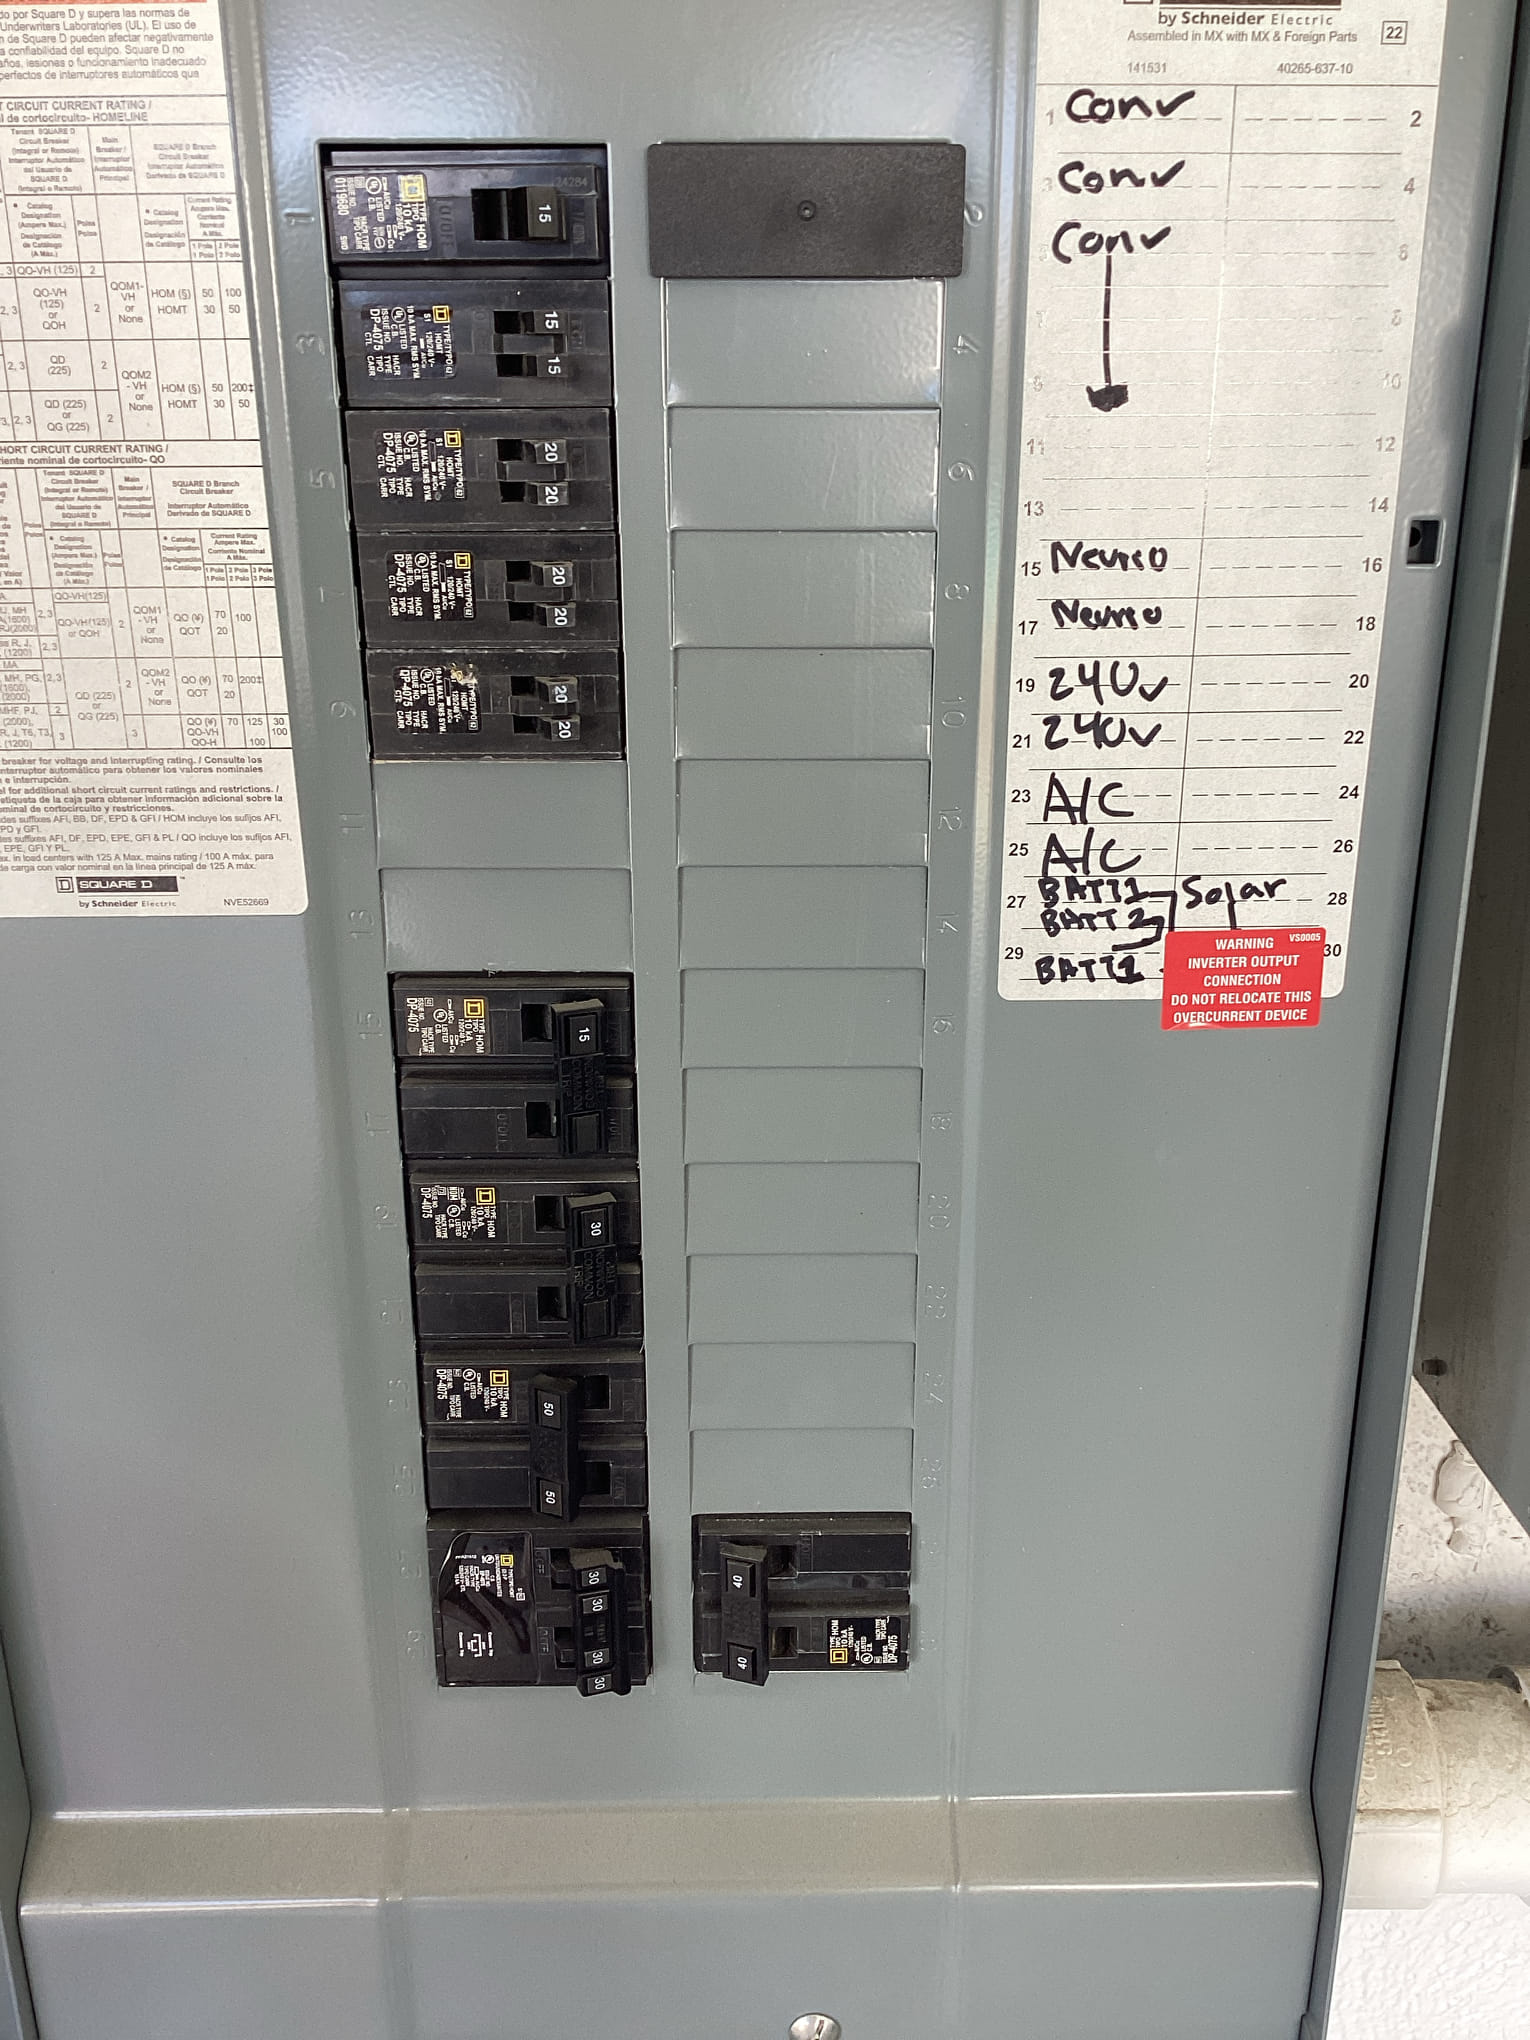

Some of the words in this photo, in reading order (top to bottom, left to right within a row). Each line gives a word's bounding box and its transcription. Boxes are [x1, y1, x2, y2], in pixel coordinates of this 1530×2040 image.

[13, 11, 28, 20] por
[31, 9, 65, 20] Square
[68, 8, 76, 18] D
[79, 11, 85, 20] y
[87, 10, 120, 20] supera
[122, 8, 137, 18] las
[139, 9, 175, 18] normas
[177, 8, 190, 18] de
[1158, 12, 1176, 27] by
[1181, 11, 1264, 25] Schneider
[1270, 13, 1333, 26] Electric
[1127, 30, 1188, 42] Assembled
[1192, 30, 1201, 42] in
[1204, 30, 1223, 42] MX
[1226, 30, 1248, 42] with
[1251, 31, 1270, 42] MX
[1273, 31, 1280, 42] &
[1284, 31, 1325, 45] Foreign
[1329, 31, 1357, 42] Parts
[1385, 26, 1403, 39] 22
[1127, 62, 1167, 74] 141531
[1276, 63, 1353, 75] 40265-637-10
[6, 101, 49, 111] CIRCUIT
[52, 100, 102, 111] CURRENT
[106, 100, 146, 110] RATING
[1065, 88, 1196, 123] Conv
[7, 113, 19, 123] de
[22, 112, 90, 123] cortocircuito-
[92, 111, 149, 122] HOMELINE
[1409, 110, 1423, 127] 2
[1057, 160, 1186, 194] Conv
[1403, 178, 1416, 194] 4
[335, 177, 350, 216] 0119680
[538, 203, 551, 224] 15
[417, 224, 426, 249] HOM
[1051, 220, 1172, 264] Conv
[151, 288, 175, 298] HOM
[201, 288, 214, 298] 50
[225, 288, 242, 298] 100
[157, 305, 188, 314] HOMT
[203, 304, 216, 314] 30
[228, 304, 241, 314] 50
[545, 311, 559, 330] 15
[369, 308, 383, 351] DP-4075
[547, 356, 561, 376] 15
[31, 444, 72, 455] CIRCUIT
[73, 444, 124, 454] CURRENT
[125, 443, 163, 453] RATING
[1375, 436, 1396, 453] 12
[27, 455, 66, 465] nominal
[67, 455, 81, 465] de
[82, 455, 148, 465] cortocircuito-
[149, 455, 166, 465] QO
[383, 432, 396, 473] DP-4075
[545, 442, 558, 463] 20
[446, 456, 454, 478] HOMT
[545, 486, 559, 505] 20
[1023, 501, 1045, 517] 13
[1368, 496, 1390, 513] 14
[1020, 561, 1042, 577] 15
[1362, 557, 1383, 573] 16
[393, 553, 406, 593] DP-4075
[552, 566, 565, 586] 20
[554, 607, 568, 627] 20
[1356, 616, 1376, 632] 18
[1018, 620, 1038, 636] 17
[399, 669, 412, 707] DP-4075
[1016, 678, 1036, 693] 19
[1348, 674, 1370, 689] 20
[555, 685, 568, 704] 20
[247, 717, 263, 727] 125
[272, 717, 285, 726] 30
[186, 727, 219, 737] QO-VH
[271, 727, 288, 736] 100
[559, 720, 572, 739] 20
[1012, 734, 1032, 750] 21
[1343, 730, 1365, 745] 22
[1, 757, 37, 765] breaker
[39, 757, 52, 765] for
[55, 757, 88, 766] voltage
[90, 756, 108, 765] and
[111, 756, 163, 767] interrupting
[166, 756, 197, 765] rating.
[204, 756, 246, 764] Consulte
[247, 755, 263, 764] los
[1011, 789, 1031, 803] 23
[1043, 772, 1134, 824] A/C
[1338, 785, 1360, 800] 24
[1008, 842, 1029, 857] 25
[1041, 827, 1142, 877] A/C
[1332, 839, 1354, 854] 26
[79, 880, 137, 889] SQUARE
[141, 880, 153, 889] D
[1182, 874, 1287, 909] Solar
[79, 900, 89, 909] by
[92, 900, 138, 908] Schneider
[141, 900, 177, 908] Electric
[223, 898, 269, 907] NVE52669
[1006, 894, 1027, 909] 27
[1327, 892, 1348, 906] 28
[1215, 937, 1275, 951] WARNING
[1289, 933, 1321, 942] VS0005
[1004, 946, 1024, 961] 29
[1323, 943, 1342, 958] 30
[1187, 956, 1247, 969] INVERTER
[1250, 954, 1300, 968] OUTPUT
[1203, 973, 1282, 987] CONNECTION
[1171, 994, 1189, 1006] DO
[1191, 993, 1216, 1005] NOT
[1219, 992, 1283, 1005] RELOCATE
[1284, 990, 1312, 1003] THIS
[406, 998, 419, 1033] DP-4075
[1173, 1010, 1263, 1024] OVERCURRENT
[1264, 1008, 1308, 1021] DEVICE
[578, 1027, 590, 1043] 15
[475, 1034, 484, 1053] HOM
[420, 1187, 432, 1219] DP-4075
[487, 1220, 495, 1238] HOM
[590, 1222, 601, 1236] 30
[436, 1368, 447, 1400] DP-4075
[499, 1401, 508, 1418] HOM
[543, 1402, 554, 1417] 50
[545, 1490, 556, 1504] 50
[588, 1571, 599, 1585] 30
[733, 1575, 743, 1589] 40
[592, 1598, 603, 1612] 30
[831, 1620, 839, 1636] HOM
[888, 1635, 898, 1664] DP-4075
[592, 1651, 603, 1665] 30
[737, 1656, 748, 1670] 40
[594, 1677, 605, 1690] 30
